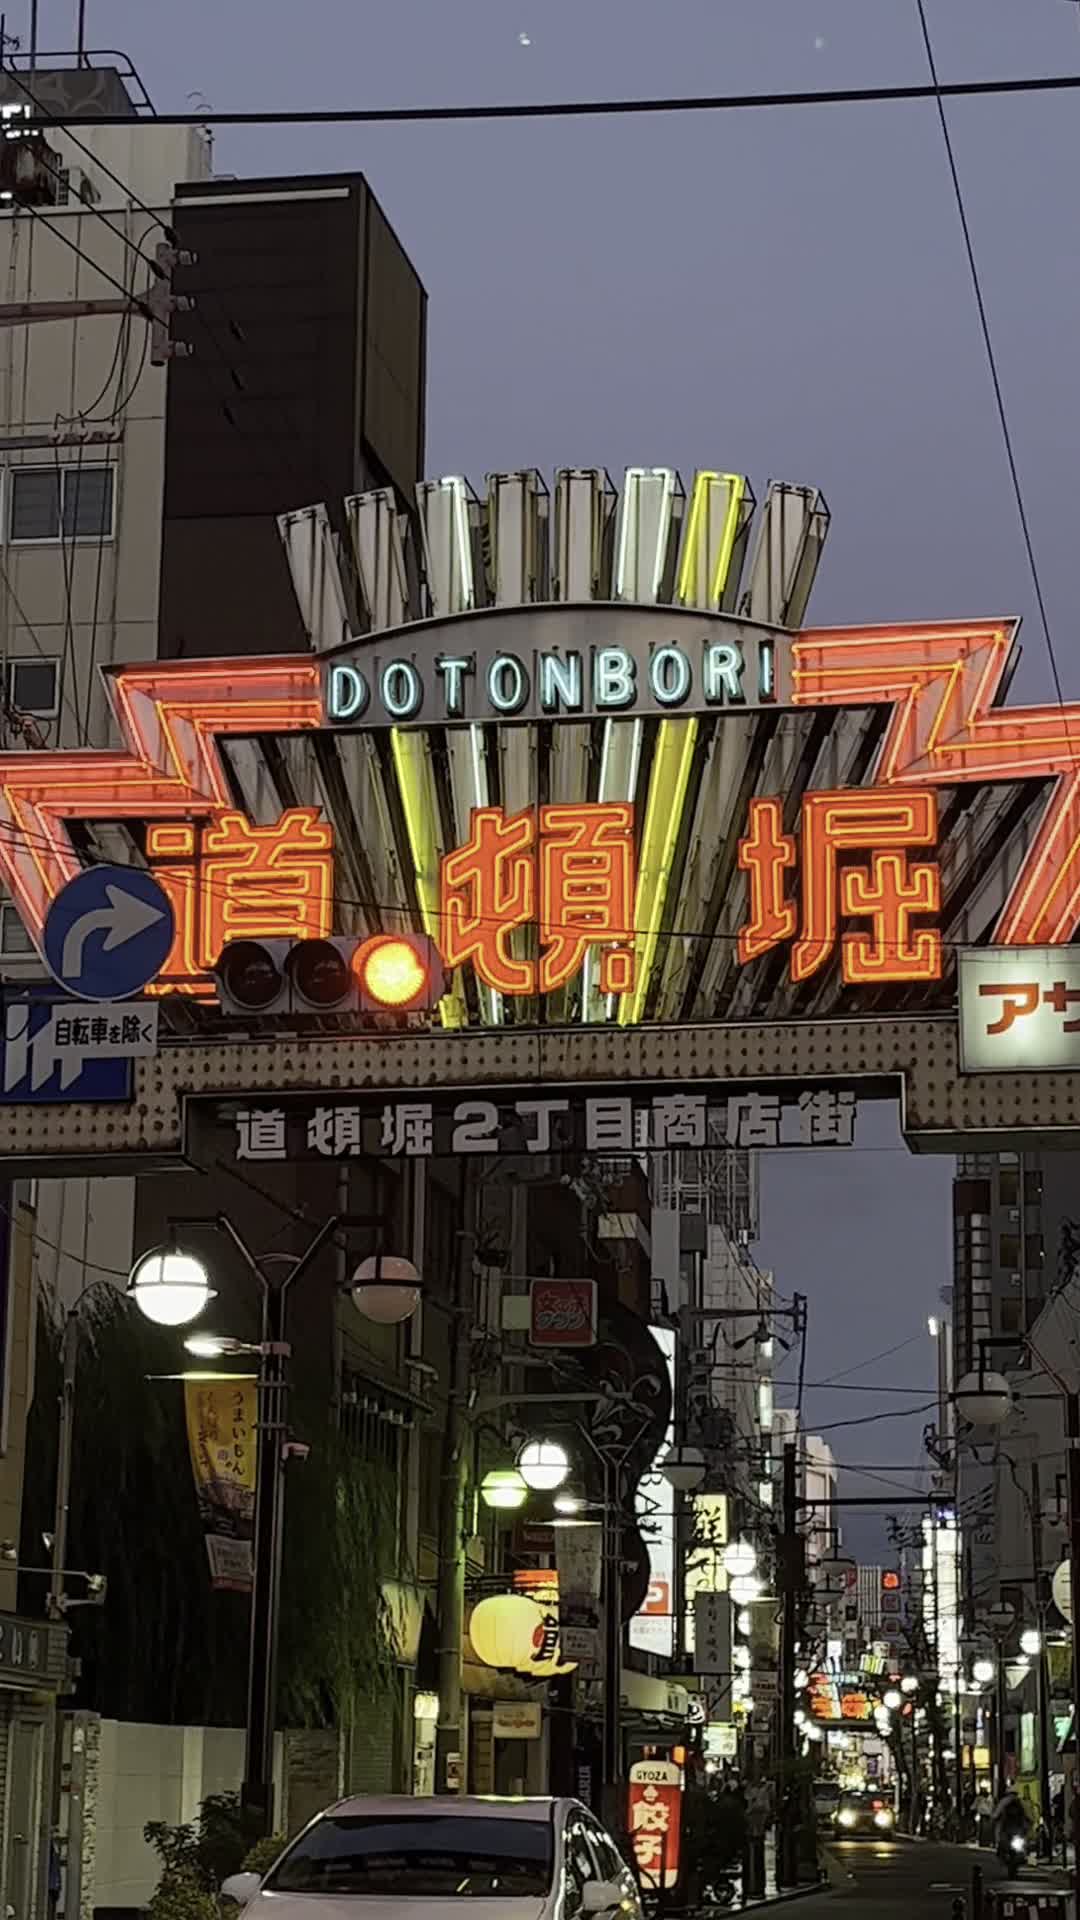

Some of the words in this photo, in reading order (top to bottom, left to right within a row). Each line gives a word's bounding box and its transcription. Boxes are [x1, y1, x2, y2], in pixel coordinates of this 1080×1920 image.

[327, 640, 774, 722] DOTONBORI
[143, 787, 943, 1004] 道頓堀
[55, 1014, 153, 1046] 自転車を除く
[235, 1090, 858, 1160] 道頓堀2丁目商店街
[635, 1770, 669, 1782] GYOZA
